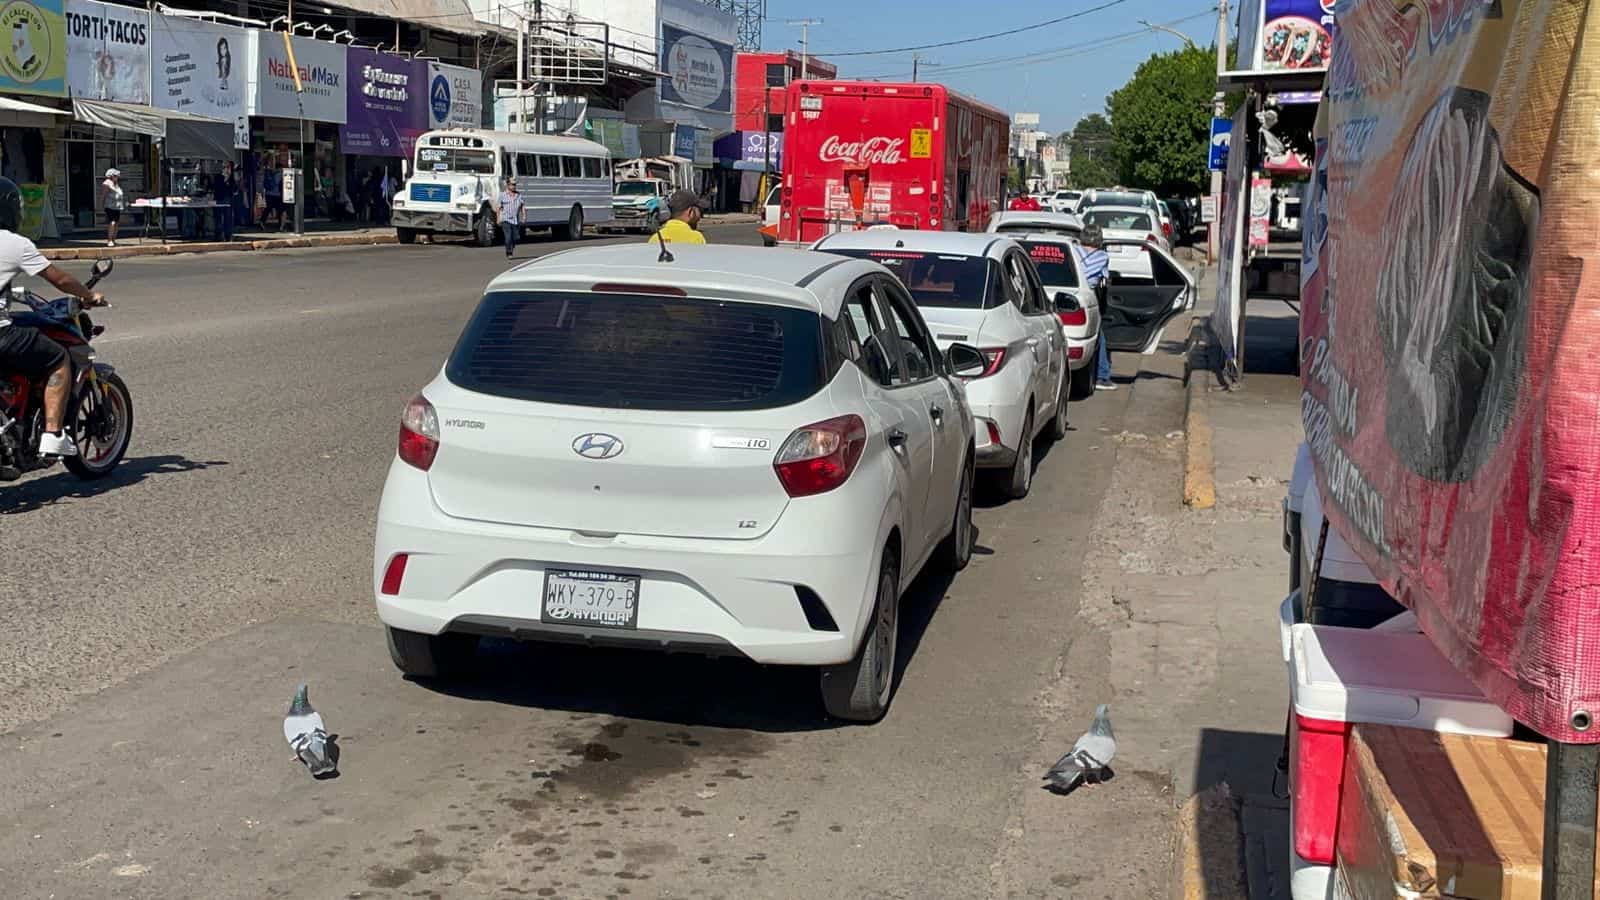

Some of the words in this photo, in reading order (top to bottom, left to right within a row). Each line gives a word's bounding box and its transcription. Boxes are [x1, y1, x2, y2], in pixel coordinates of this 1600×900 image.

[317, 66, 339, 88] Max
[439, 137, 464, 147] LINEA
[467, 138, 474, 147] 4
[444, 418, 486, 430] HYUNDAI
[547, 583, 635, 609] WKY-379-B
[573, 609, 630, 623] HYUNDAI
